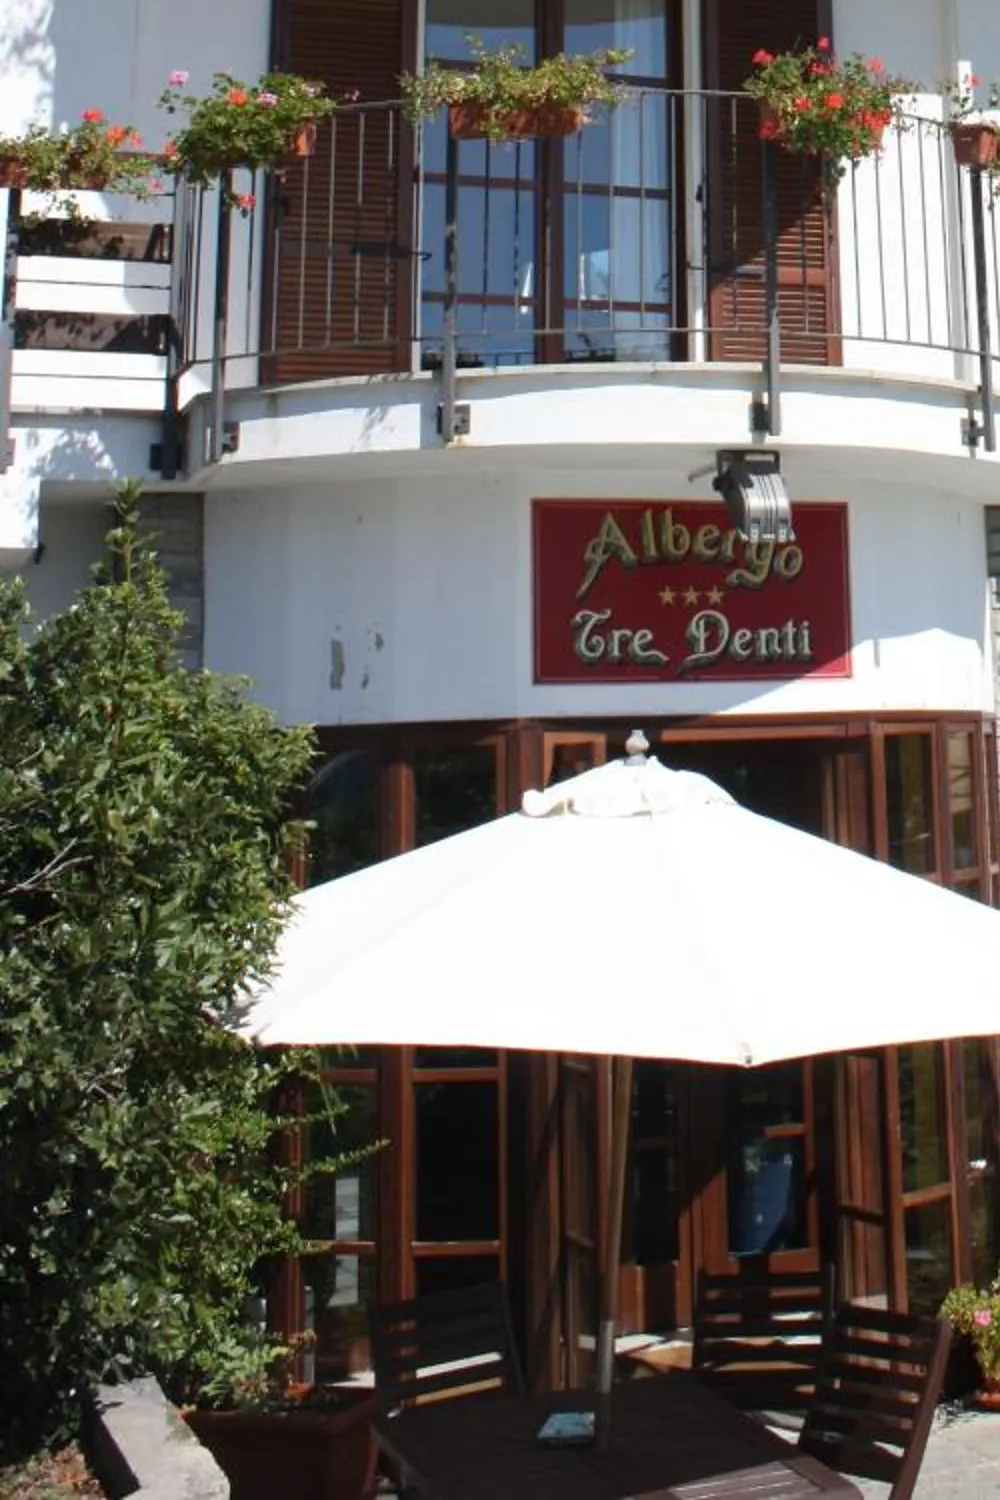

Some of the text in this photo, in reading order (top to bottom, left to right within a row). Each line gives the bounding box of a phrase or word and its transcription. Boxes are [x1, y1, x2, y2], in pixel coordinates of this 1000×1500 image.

[575, 506, 803, 600] Albergo
[571, 608, 813, 677] Tre Denti
